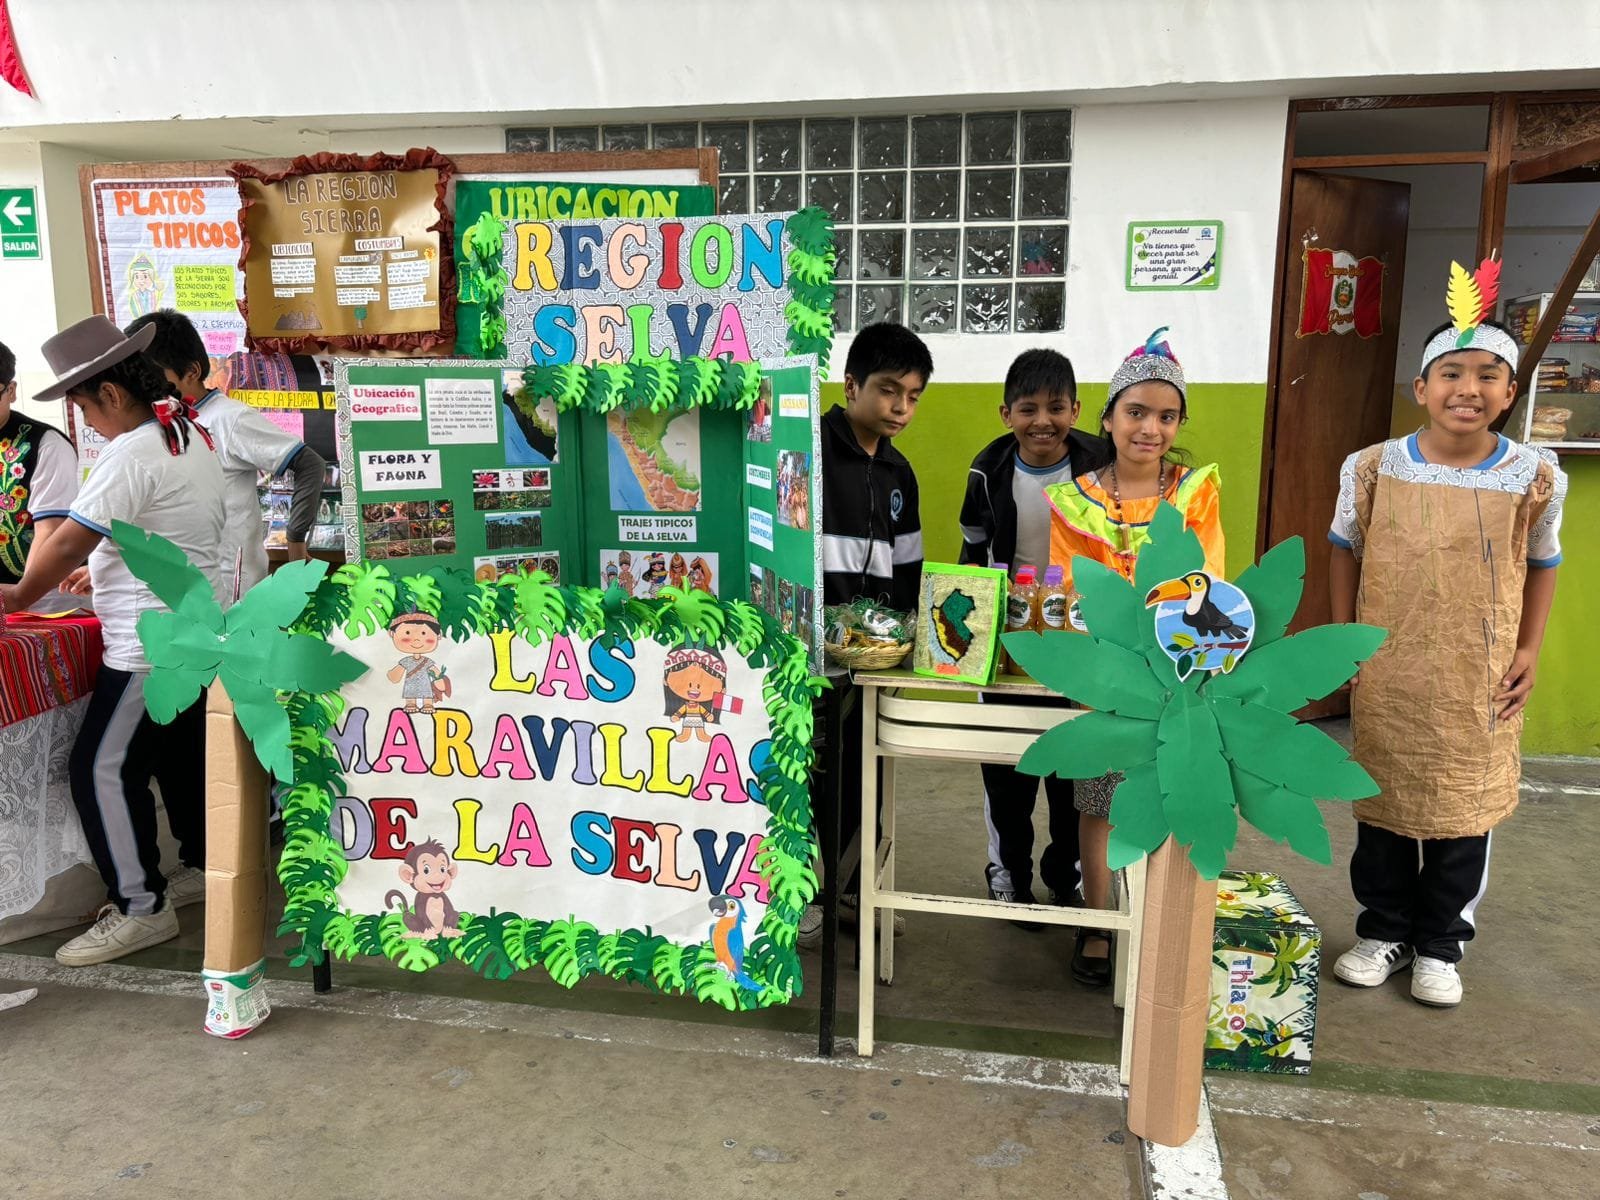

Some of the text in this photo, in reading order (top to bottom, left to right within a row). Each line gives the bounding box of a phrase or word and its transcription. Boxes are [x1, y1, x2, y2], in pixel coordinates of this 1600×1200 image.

[284, 174, 397, 205] LA REGION
[114, 188, 206, 216] PLATOS
[489, 186, 679, 219] UBICACION
[301, 206, 383, 235] SIERRA
[147, 220, 240, 249] TIPICOS
[4, 241, 37, 252] SALIDA
[1180, 243, 1196, 251] que
[511, 220, 784, 291] REGION
[1164, 251, 1184, 259] para
[1134, 266, 1168, 275] persona,
[1152, 273, 1178, 282] genial.
[531, 303, 750, 365] SELVA
[231, 391, 314, 407] QUE ES LA FLORA
[353, 387, 416, 399] Ubicación
[352, 404, 419, 415] Geografica
[368, 454, 432, 465] FLORA Y
[375, 470, 427, 482] FAUNA
[620, 518, 693, 528] TRAJES TIPICOS
[626, 531, 687, 541] DE LA SELVA
[488, 626, 636, 703] LAS
[330, 797, 772, 904] DE LA SELVA
[1227, 955, 1254, 1032] Thiago
